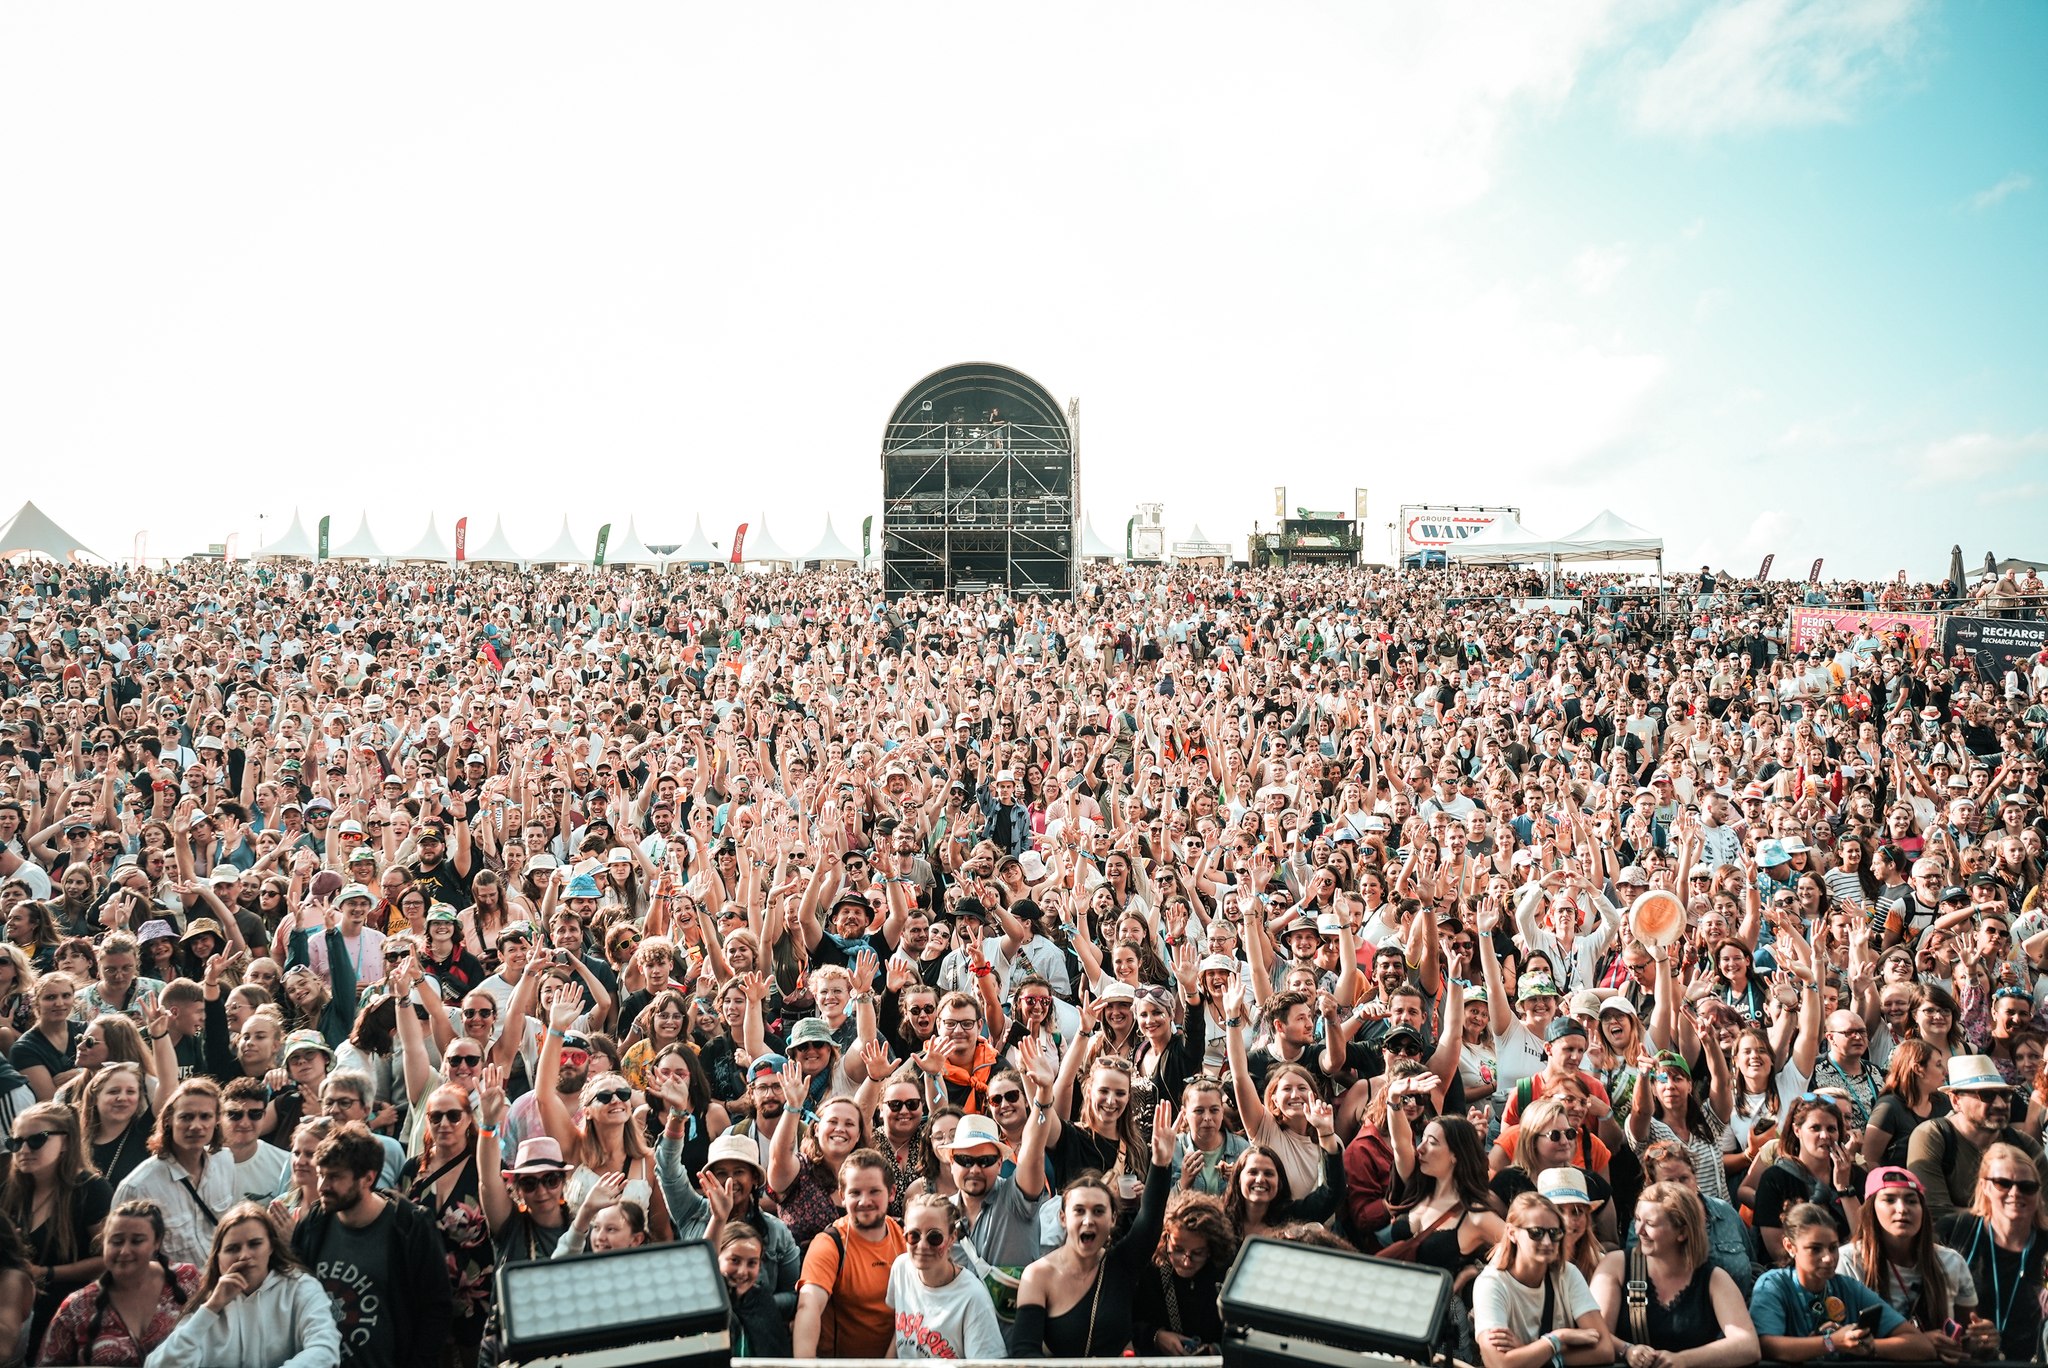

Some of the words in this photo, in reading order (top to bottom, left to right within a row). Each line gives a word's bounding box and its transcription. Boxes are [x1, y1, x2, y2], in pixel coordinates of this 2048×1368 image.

[1421, 525, 1484, 539] WANT
[1801, 617, 1836, 627] PERDE
[1982, 626, 2045, 640] RECHARGE
[1981, 638, 2013, 646] RECHARGE
